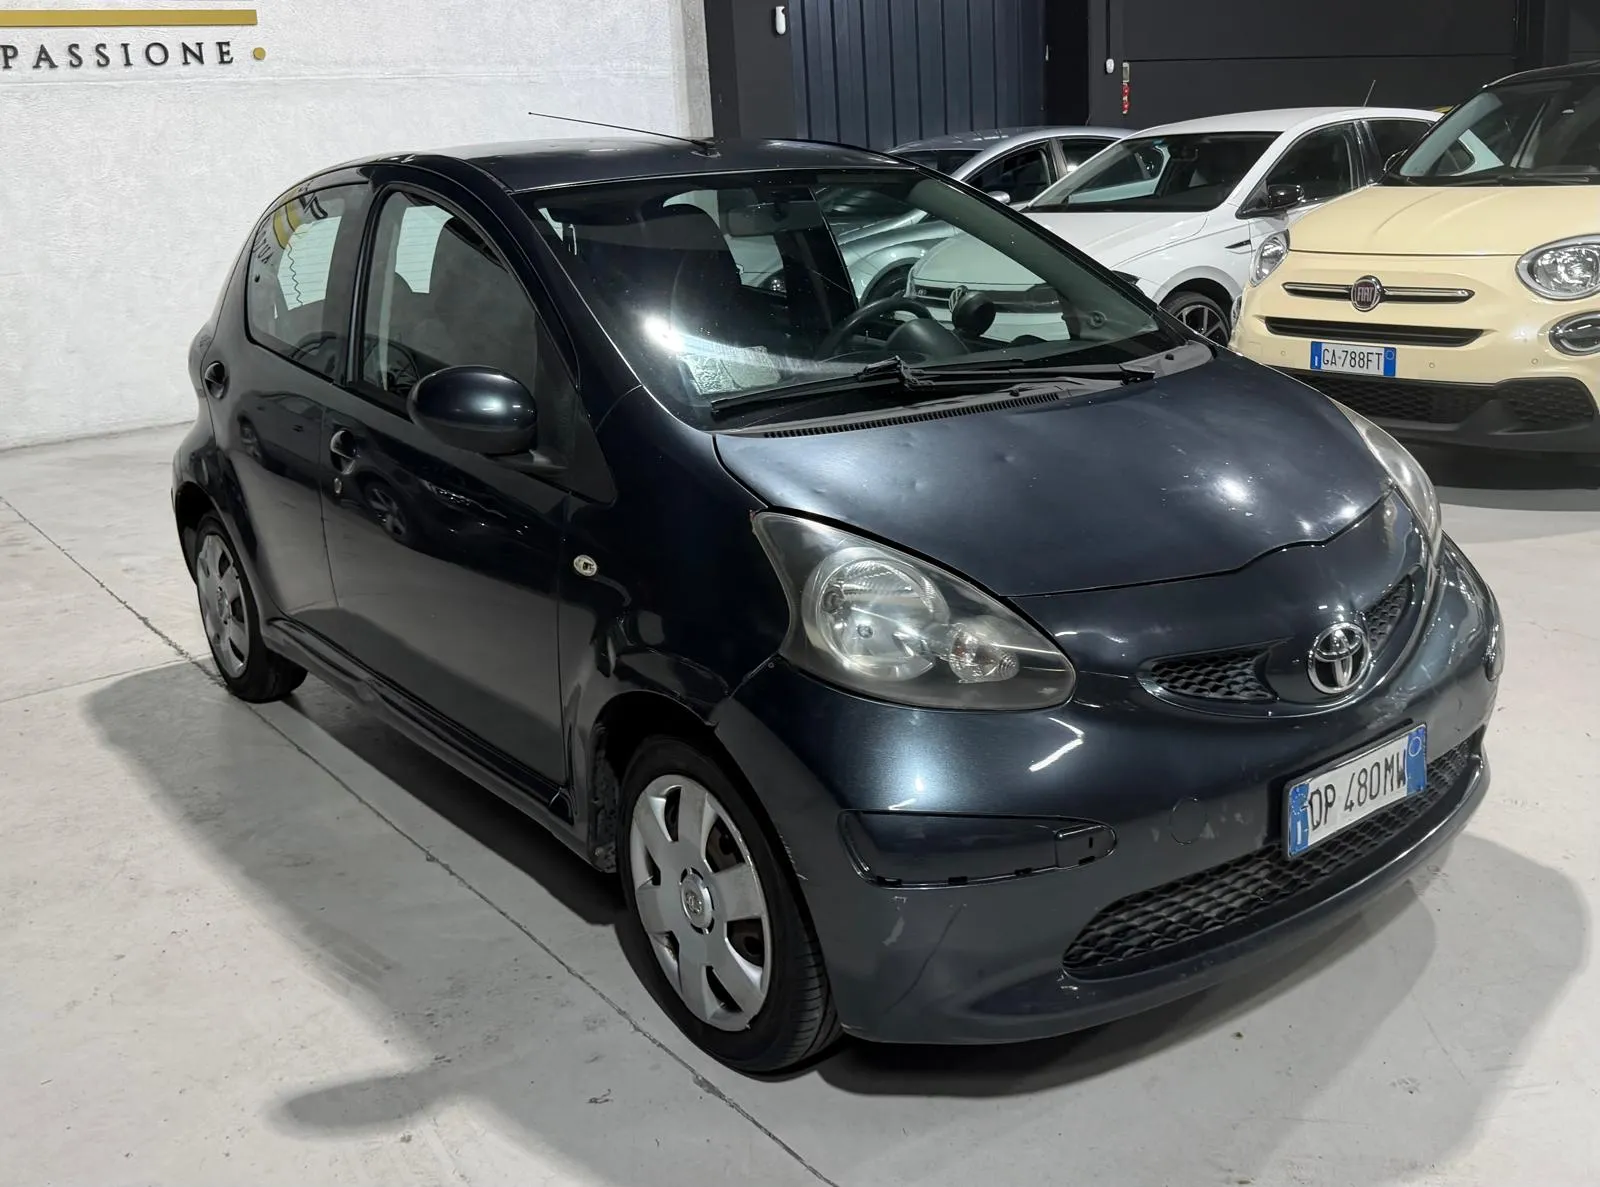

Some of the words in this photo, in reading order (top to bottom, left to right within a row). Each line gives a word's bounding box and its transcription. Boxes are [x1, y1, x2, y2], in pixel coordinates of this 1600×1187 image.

[0, 41, 234, 69] PASSIONE
[1357, 286, 1374, 302] FIAT
[1344, 748, 1406, 811] 480MW
